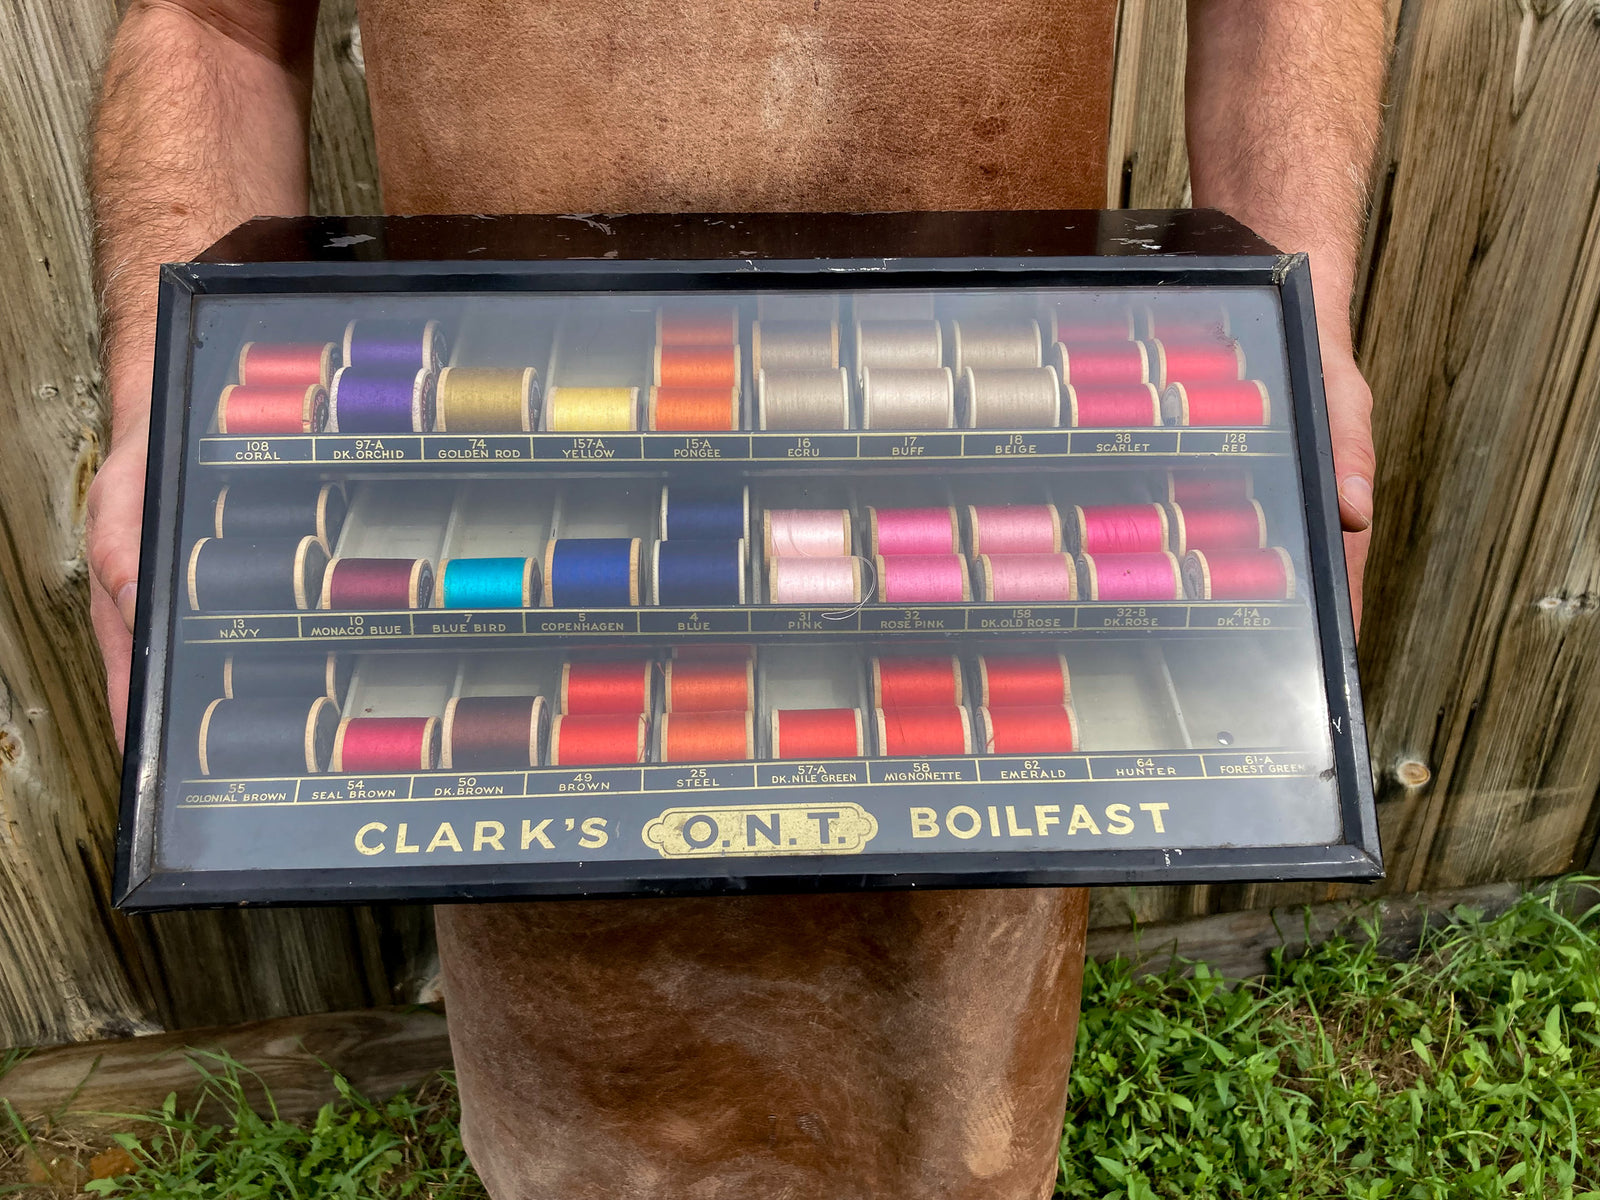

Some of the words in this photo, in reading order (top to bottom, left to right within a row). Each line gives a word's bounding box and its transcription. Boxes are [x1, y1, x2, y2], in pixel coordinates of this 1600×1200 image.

[905, 437, 917, 446] 17
[1010, 435, 1023, 444] 18
[1116, 434, 1131, 443] 38
[1225, 433, 1245, 443] 128
[247, 441, 269, 451] 108
[355, 440, 384, 450] 97-A
[469, 439, 486, 449] 74
[686, 438, 711, 449] 15-A
[797, 438, 811, 448] 16
[1096, 443, 1150, 452] SCARLET
[788, 448, 820, 457] ECRU
[892, 447, 925, 456] BUFF
[995, 445, 1036, 454] BEIGE
[1222, 444, 1248, 452] RED
[235, 451, 280, 460] CORAL
[438, 450, 489, 459] GOLDEN
[495, 450, 520, 458] ROD
[562, 449, 615, 458] YELLOW
[674, 449, 721, 458] PONGEE
[689, 612, 698, 621] 4
[799, 612, 810, 621] 31
[905, 610, 920, 620] 32
[1013, 610, 1031, 618] 158
[1116, 608, 1146, 617] 32-B
[350, 616, 364, 626] 10
[464, 614, 473, 623] 7
[579, 613, 586, 622] 5
[1244, 618, 1271, 626] RED
[233, 619, 245, 629] 13
[541, 622, 624, 631] COPENHAGEN
[678, 622, 710, 631] BLUE
[788, 621, 822, 629] PINK
[880, 620, 911, 629] ROSE
[915, 619, 944, 628] PINK
[1028, 618, 1060, 627] ROSE
[311, 626, 364, 636] MONACO
[370, 625, 402, 635] BLUE
[433, 624, 468, 632] BLUE
[474, 623, 506, 632] BIRD
[220, 629, 260, 638] NAVY
[1136, 759, 1154, 767] 64
[1245, 755, 1274, 764] 61-A
[913, 763, 930, 773] 58
[1024, 760, 1039, 769] 62
[1220, 765, 1265, 774] FOREST
[1269, 764, 1305, 773] GREEN
[690, 769, 707, 778] 25
[797, 765, 827, 774] 57-A
[1000, 769, 1066, 779] EMERALD
[1115, 766, 1177, 776] HUNTER
[574, 773, 592, 782] 49
[821, 773, 856, 782] GREEN
[884, 771, 962, 781] MIGNONETTE
[347, 780, 365, 790] 54
[458, 777, 477, 787] 50
[677, 779, 720, 787] STEEL
[228, 784, 245, 794] 55
[558, 782, 610, 792] BROWN
[185, 794, 238, 803] COLONIAL
[243, 792, 286, 802] BROWN
[312, 791, 343, 800] SEAL
[349, 789, 396, 799] BROWN
[354, 817, 609, 856] CLARK'S
[909, 802, 1170, 839] BOILFAST
